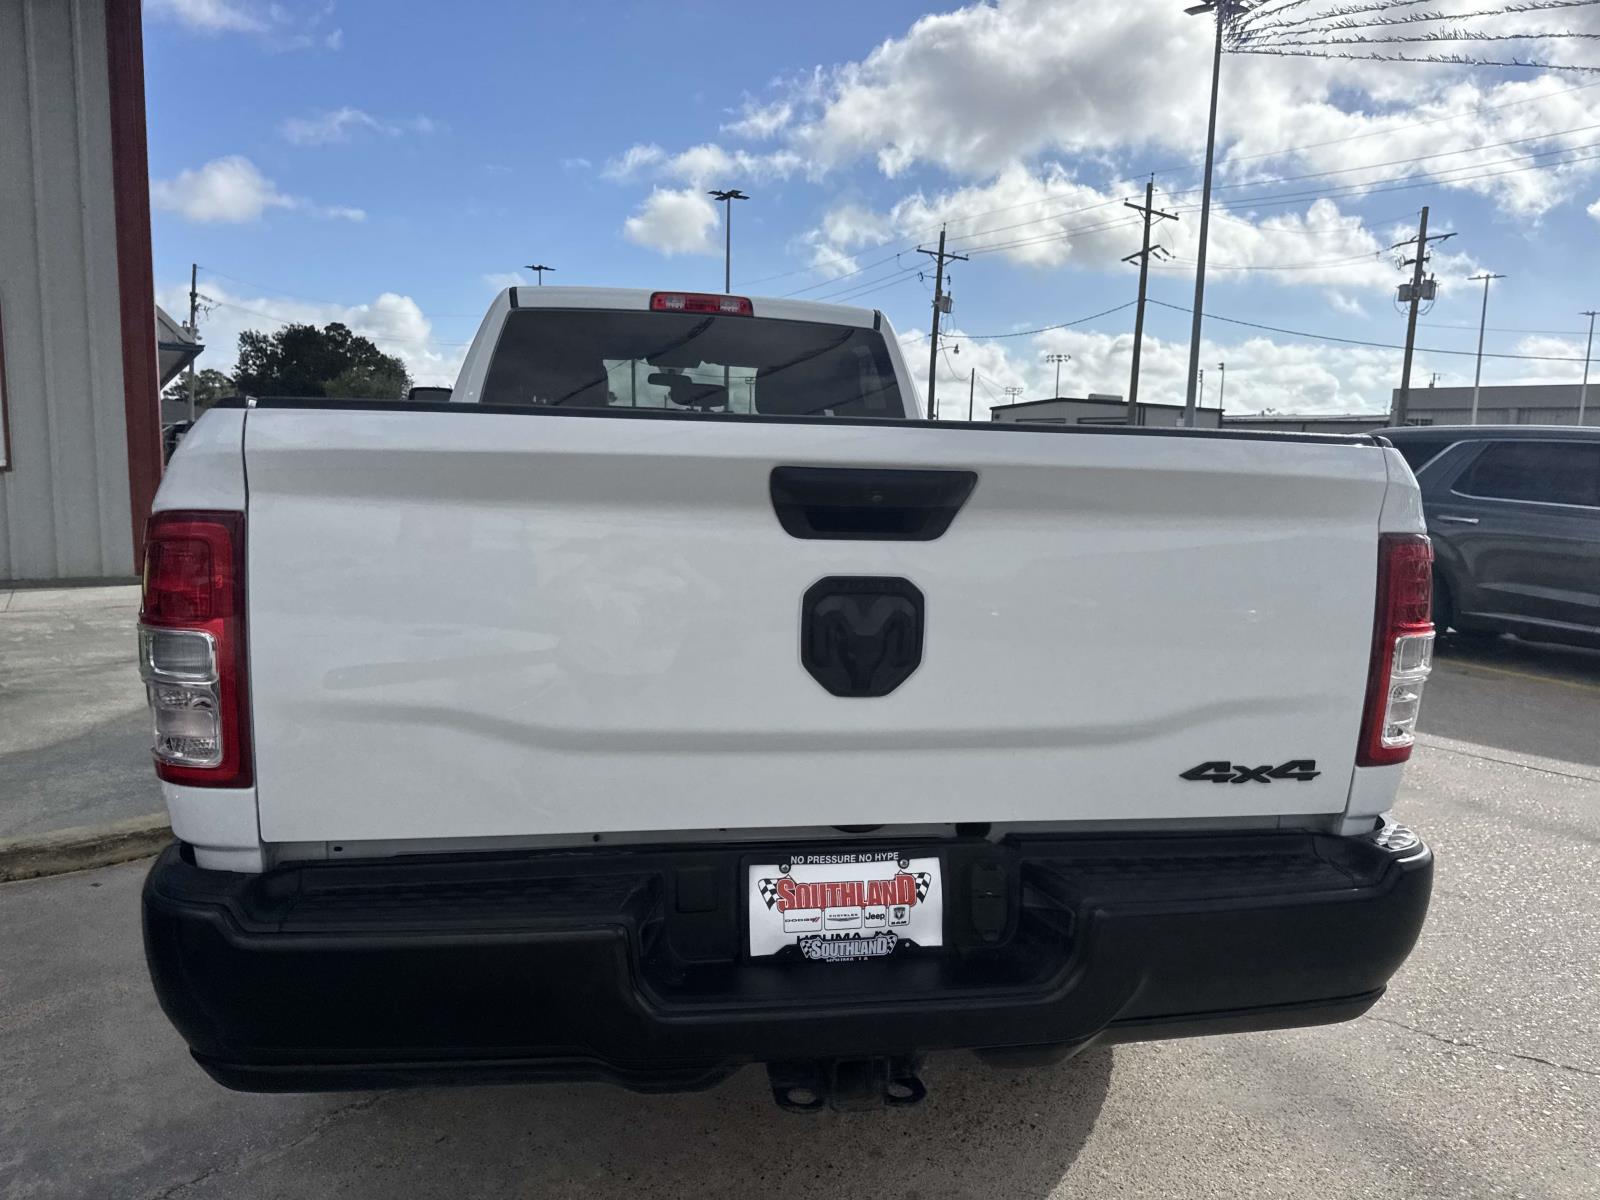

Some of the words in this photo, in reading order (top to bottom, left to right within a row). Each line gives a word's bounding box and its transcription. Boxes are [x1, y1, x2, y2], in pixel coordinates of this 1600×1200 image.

[791, 855, 804, 864] NO
[807, 854, 856, 864] PRESSURE
[858, 853, 872, 863] NO
[875, 852, 899, 861] HYPE
[776, 874, 917, 913] SOUTHLAND
[865, 912, 885, 920] Jeep
[811, 936, 888, 959] SOUTHLAND
